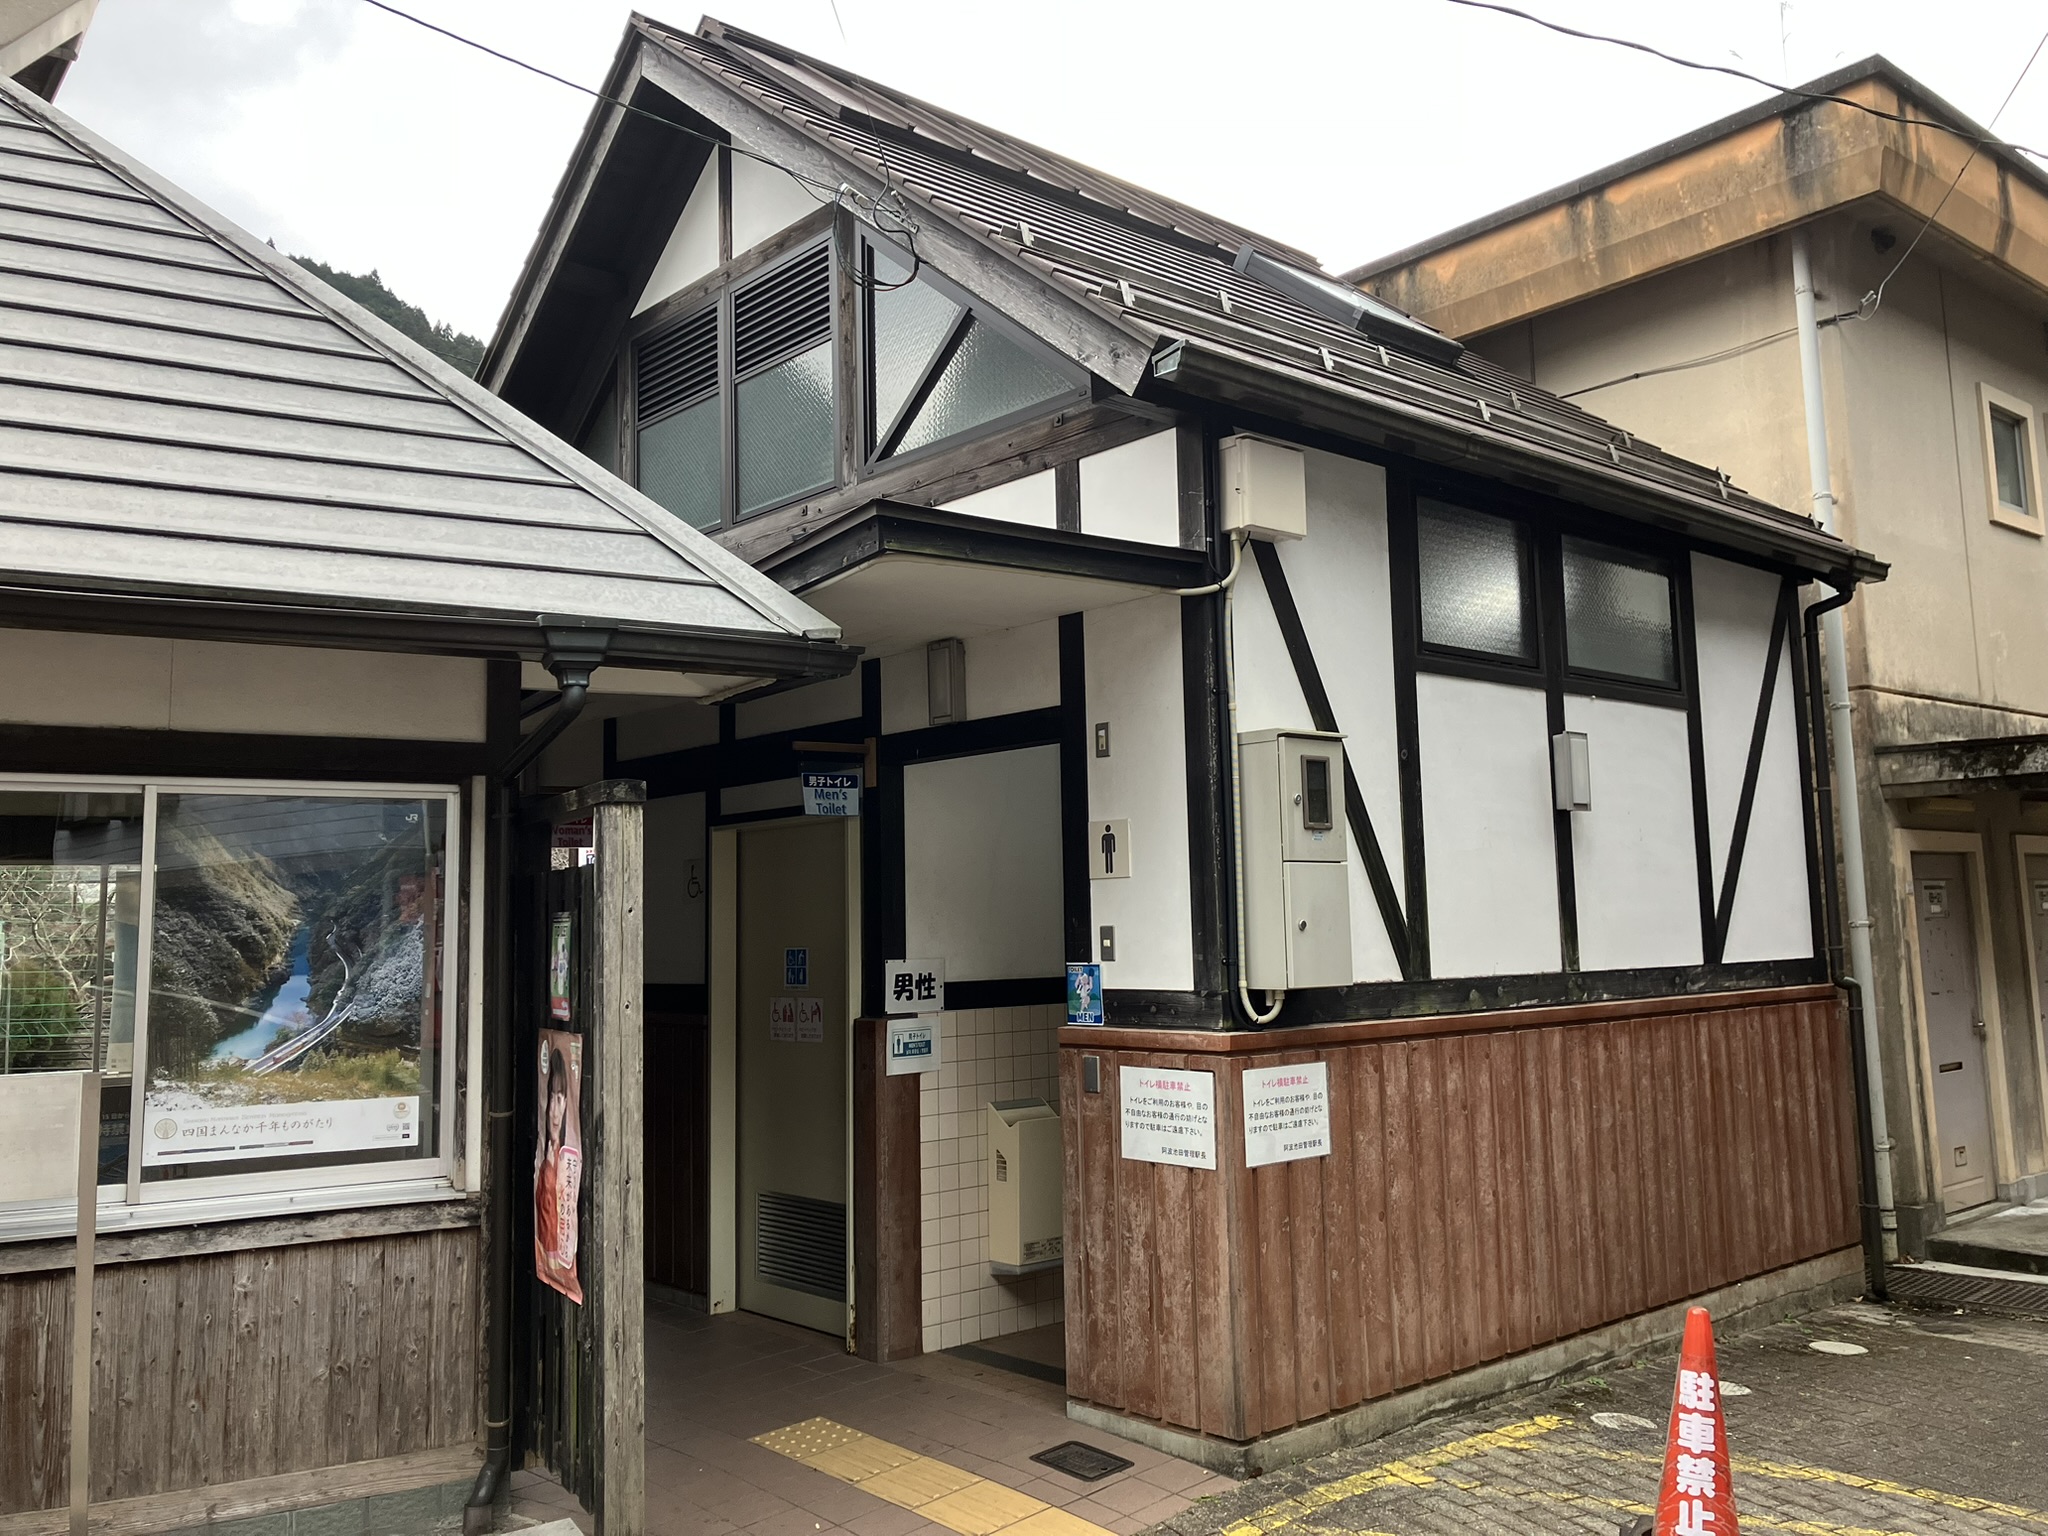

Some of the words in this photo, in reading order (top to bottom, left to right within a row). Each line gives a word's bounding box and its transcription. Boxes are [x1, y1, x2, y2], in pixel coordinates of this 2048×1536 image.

[808, 775, 852, 787] 男子トイレ
[814, 788, 848, 800] Men's
[816, 802, 847, 815] Toilet
[405, 813, 418, 821] JR
[557, 837, 583, 846] Toilet
[893, 972, 936, 1001] 男性
[1076, 1011, 1095, 1023] MEN
[1139, 1079, 1191, 1092] トイレ横駐車禁止
[1262, 1075, 1309, 1088] トイレ横駐車禁止
[181, 1116, 333, 1138] 四国まんなか千年ものがたり
[1161, 1146, 1207, 1159] 阿波池田管理駅長
[1675, 1369, 1716, 1536] 駐車禁止
